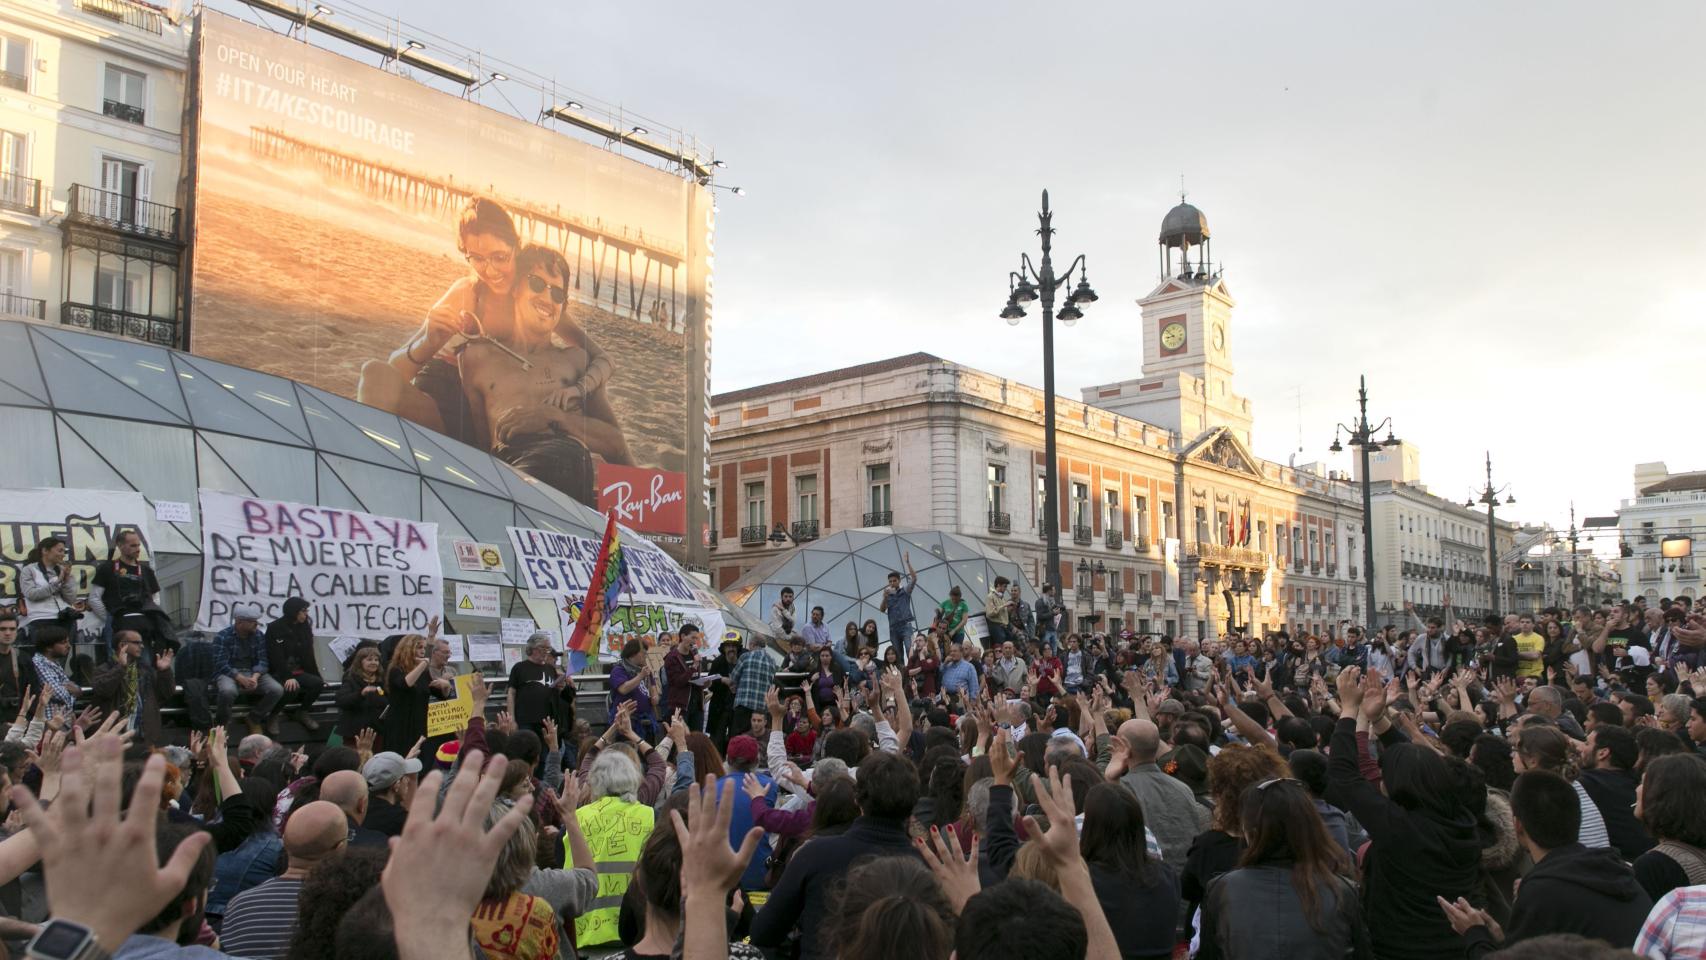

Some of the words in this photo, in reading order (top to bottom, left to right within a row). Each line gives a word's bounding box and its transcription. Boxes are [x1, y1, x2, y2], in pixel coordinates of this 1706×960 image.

[217, 44, 260, 73] OPEN
[265, 59, 305, 88] YOUR
[311, 76, 358, 104] HEART
[216, 72, 415, 155] #ITTAKESCOURAGE
[243, 500, 374, 540] BASTA
[374, 518, 428, 550] YA
[211, 533, 258, 562] DE
[269, 536, 410, 571] MUERTES
[515, 530, 542, 556] LA
[539, 532, 586, 562] LUCHA
[211, 565, 259, 594] EN
[269, 571, 303, 598] LA
[311, 573, 390, 597] CALLE
[402, 574, 433, 596] DE
[525, 557, 558, 590] ES
[557, 560, 588, 590] EL
[632, 567, 695, 600] CAMINO
[347, 603, 429, 631] TECHO
[610, 605, 668, 634] 15M
